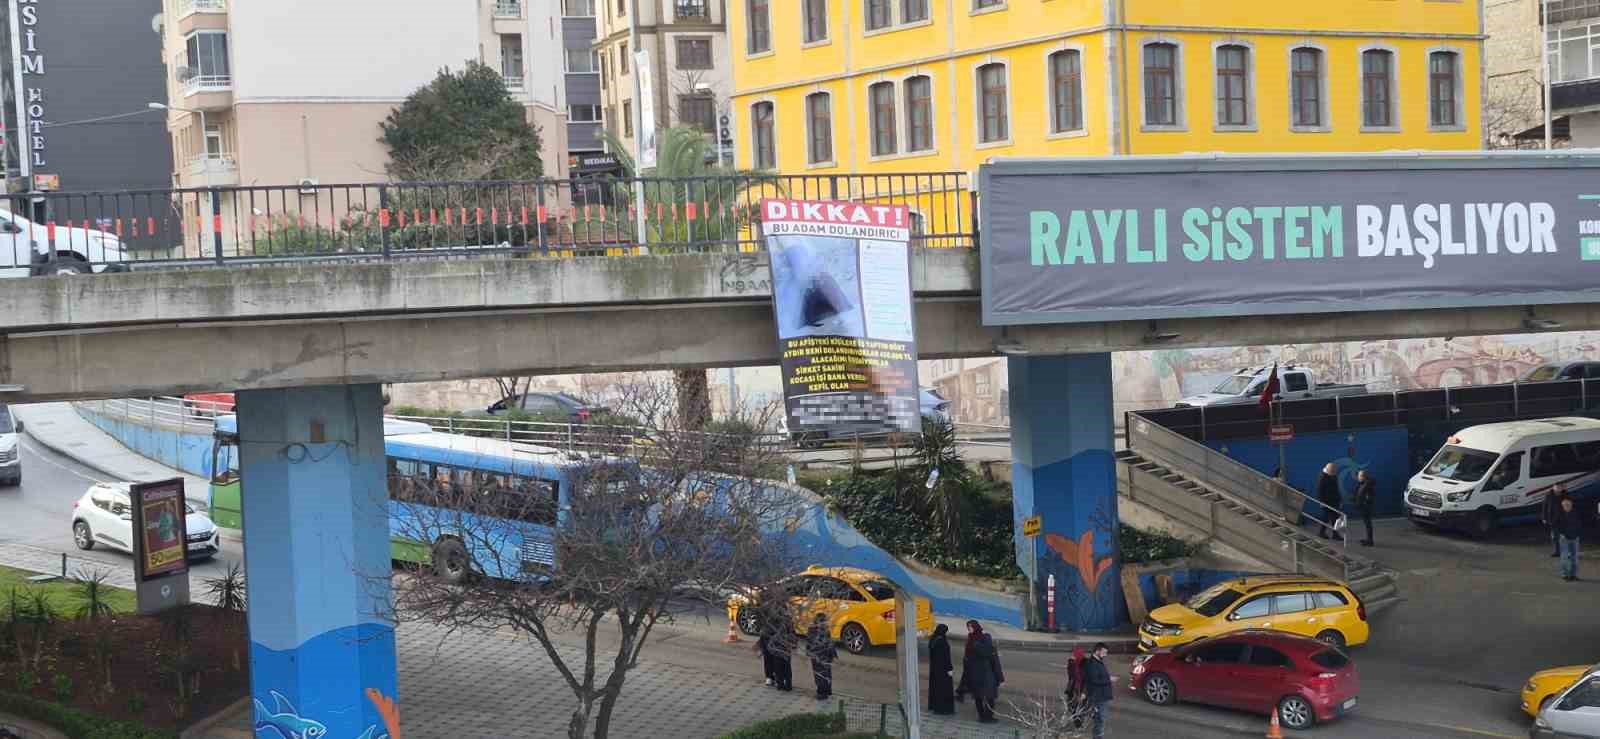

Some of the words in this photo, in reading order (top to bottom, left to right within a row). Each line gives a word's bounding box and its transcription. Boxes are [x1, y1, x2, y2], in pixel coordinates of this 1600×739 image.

[20, 0, 45, 74] SİM
[28, 88, 45, 165] HOTEL
[773, 223, 788, 233] BU
[792, 224, 826, 234] ADAM
[829, 225, 900, 239] DOLANDIRICI
[1030, 209, 1167, 265] RAYLI
[1357, 202, 1557, 268] BAŞLIYOR
[831, 382, 849, 390] OLAN
